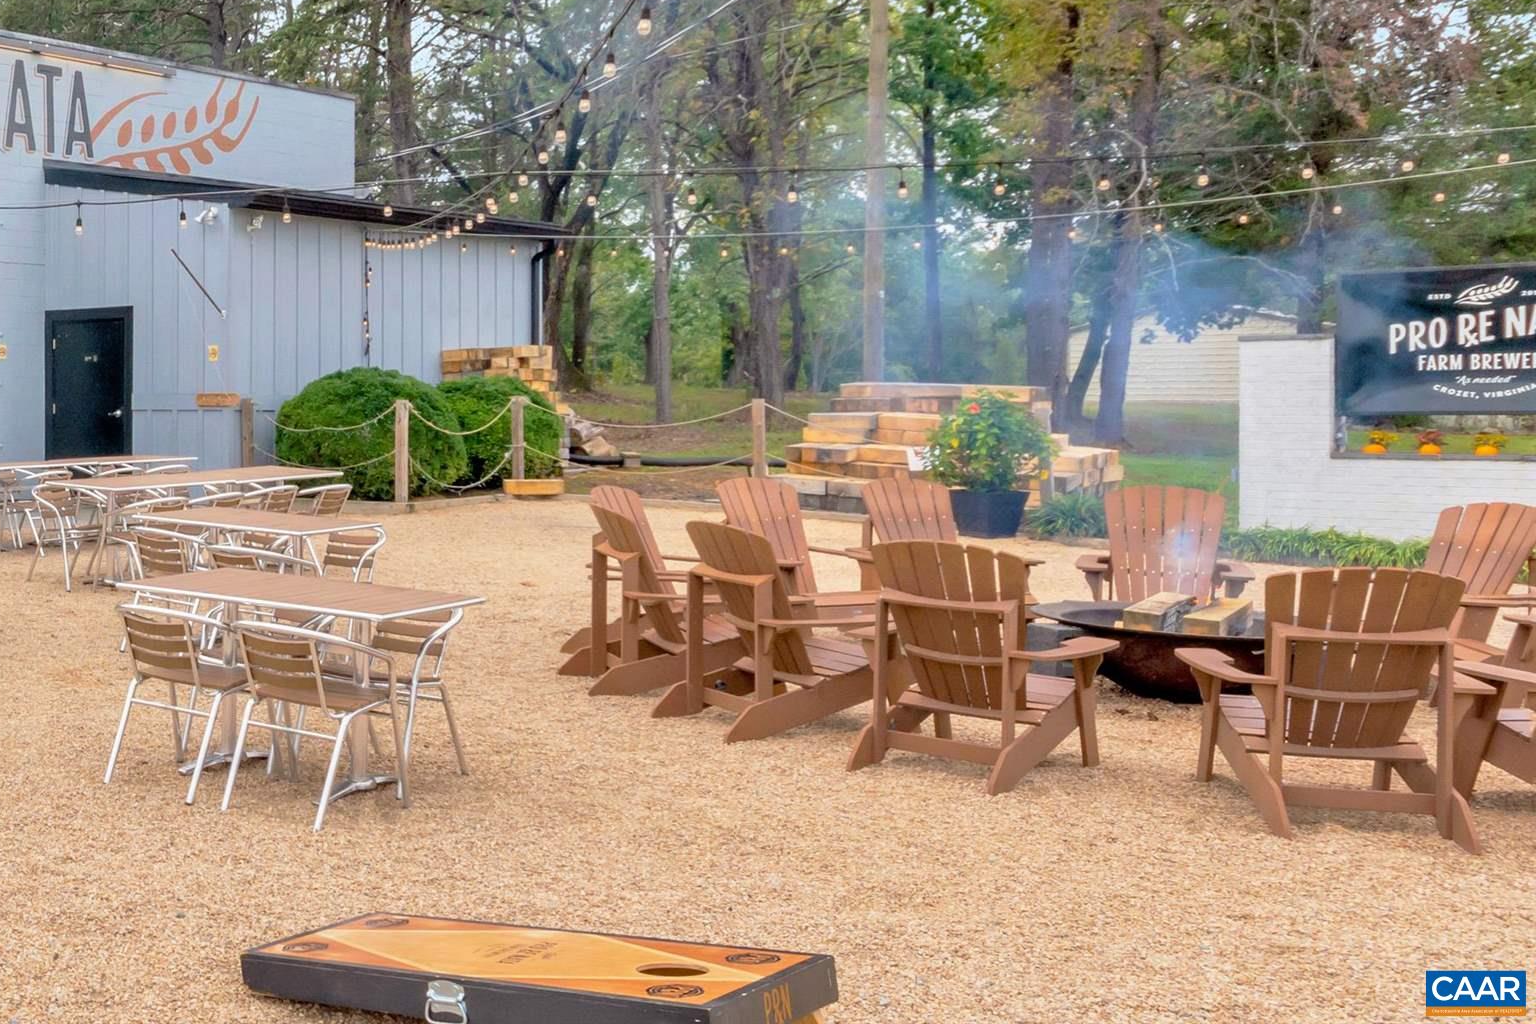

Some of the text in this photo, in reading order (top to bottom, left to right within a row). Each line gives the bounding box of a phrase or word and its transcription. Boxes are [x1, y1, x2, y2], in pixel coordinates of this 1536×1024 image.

[1389, 316, 1448, 355] PRO
[1417, 354, 1463, 371] FARM
[764, 982, 792, 1024] PRN
